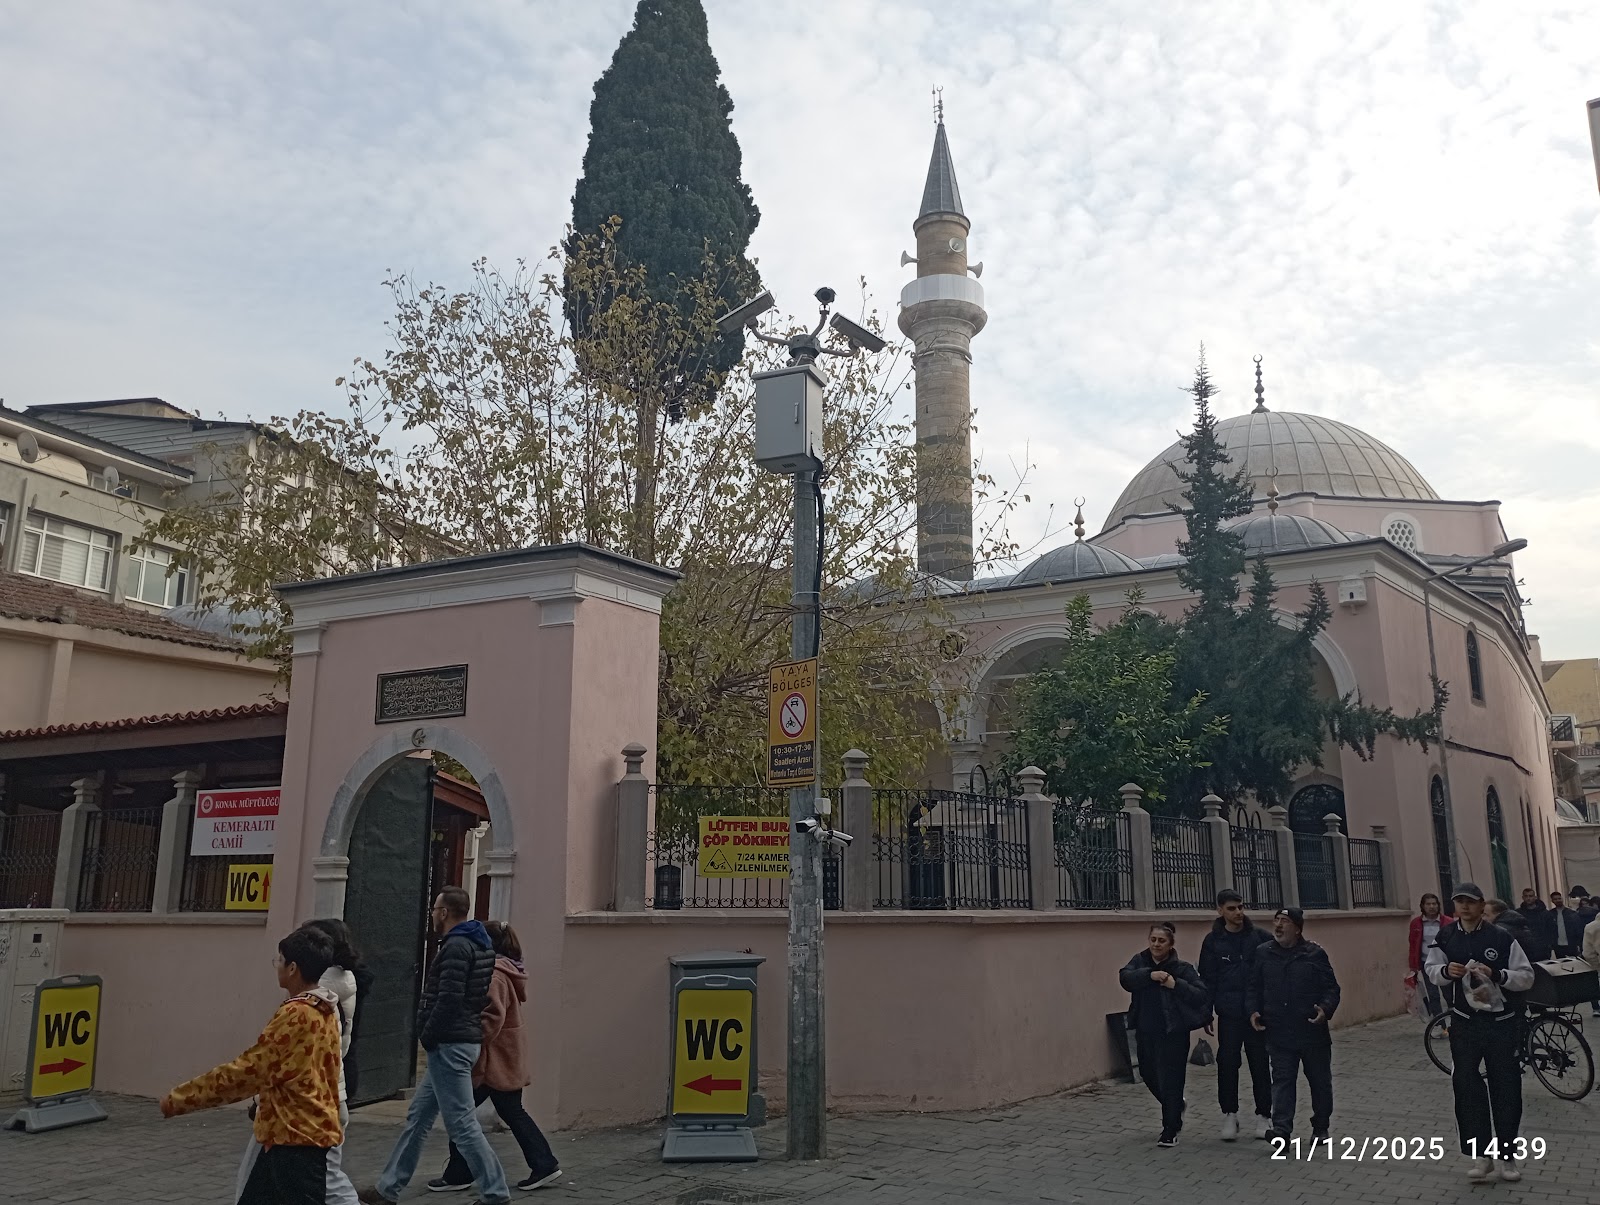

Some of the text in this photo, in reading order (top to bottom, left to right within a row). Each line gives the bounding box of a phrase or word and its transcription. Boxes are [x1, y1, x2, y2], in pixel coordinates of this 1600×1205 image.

[780, 664, 809, 677] YAYA
[772, 673, 815, 692] BÖLGESİ
[215, 800, 238, 809] KONAK
[213, 820, 275, 833] KEMERALTI
[708, 819, 758, 832] LÜTFEN
[211, 834, 243, 849] CAMİİ
[702, 833, 730, 848] ÇÖP
[737, 853, 755, 861] 7/24
[734, 862, 789, 872] İZLENİLMEK
[230, 872, 260, 902] WC
[44, 1010, 91, 1049] WC
[685, 1018, 744, 1061] WC
